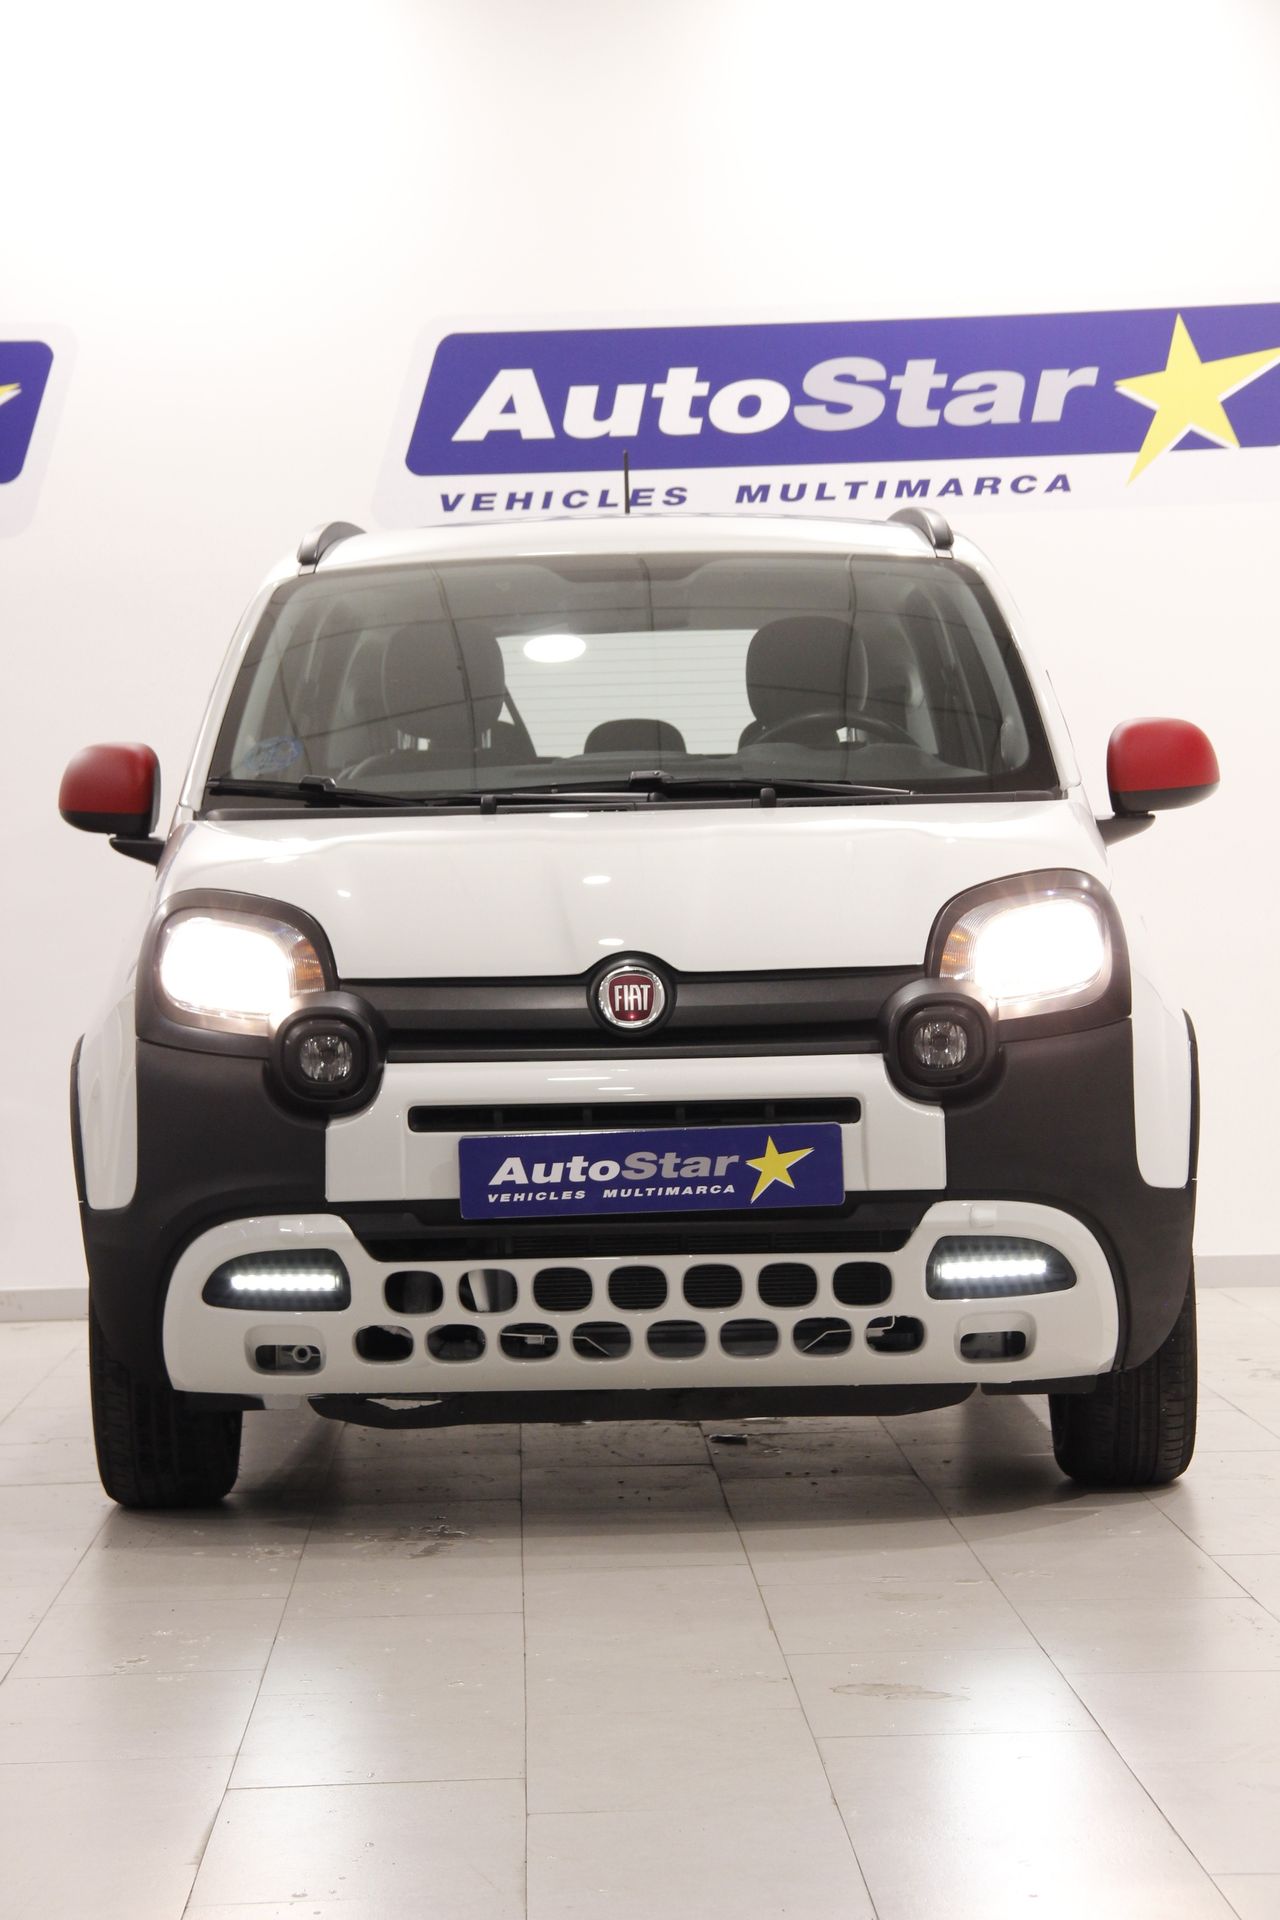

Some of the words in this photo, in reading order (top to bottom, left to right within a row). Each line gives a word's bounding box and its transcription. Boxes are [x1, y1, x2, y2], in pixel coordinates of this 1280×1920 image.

[451, 356, 1099, 442] AutoStar
[440, 487, 687, 513] VEHICLES
[735, 474, 1072, 504] MULTIMARCA
[614, 984, 651, 1011] FIAT
[488, 1151, 739, 1186] AutoStar
[488, 1190, 585, 1203] VEHICLES
[602, 1184, 736, 1199] MULTIMARCA
